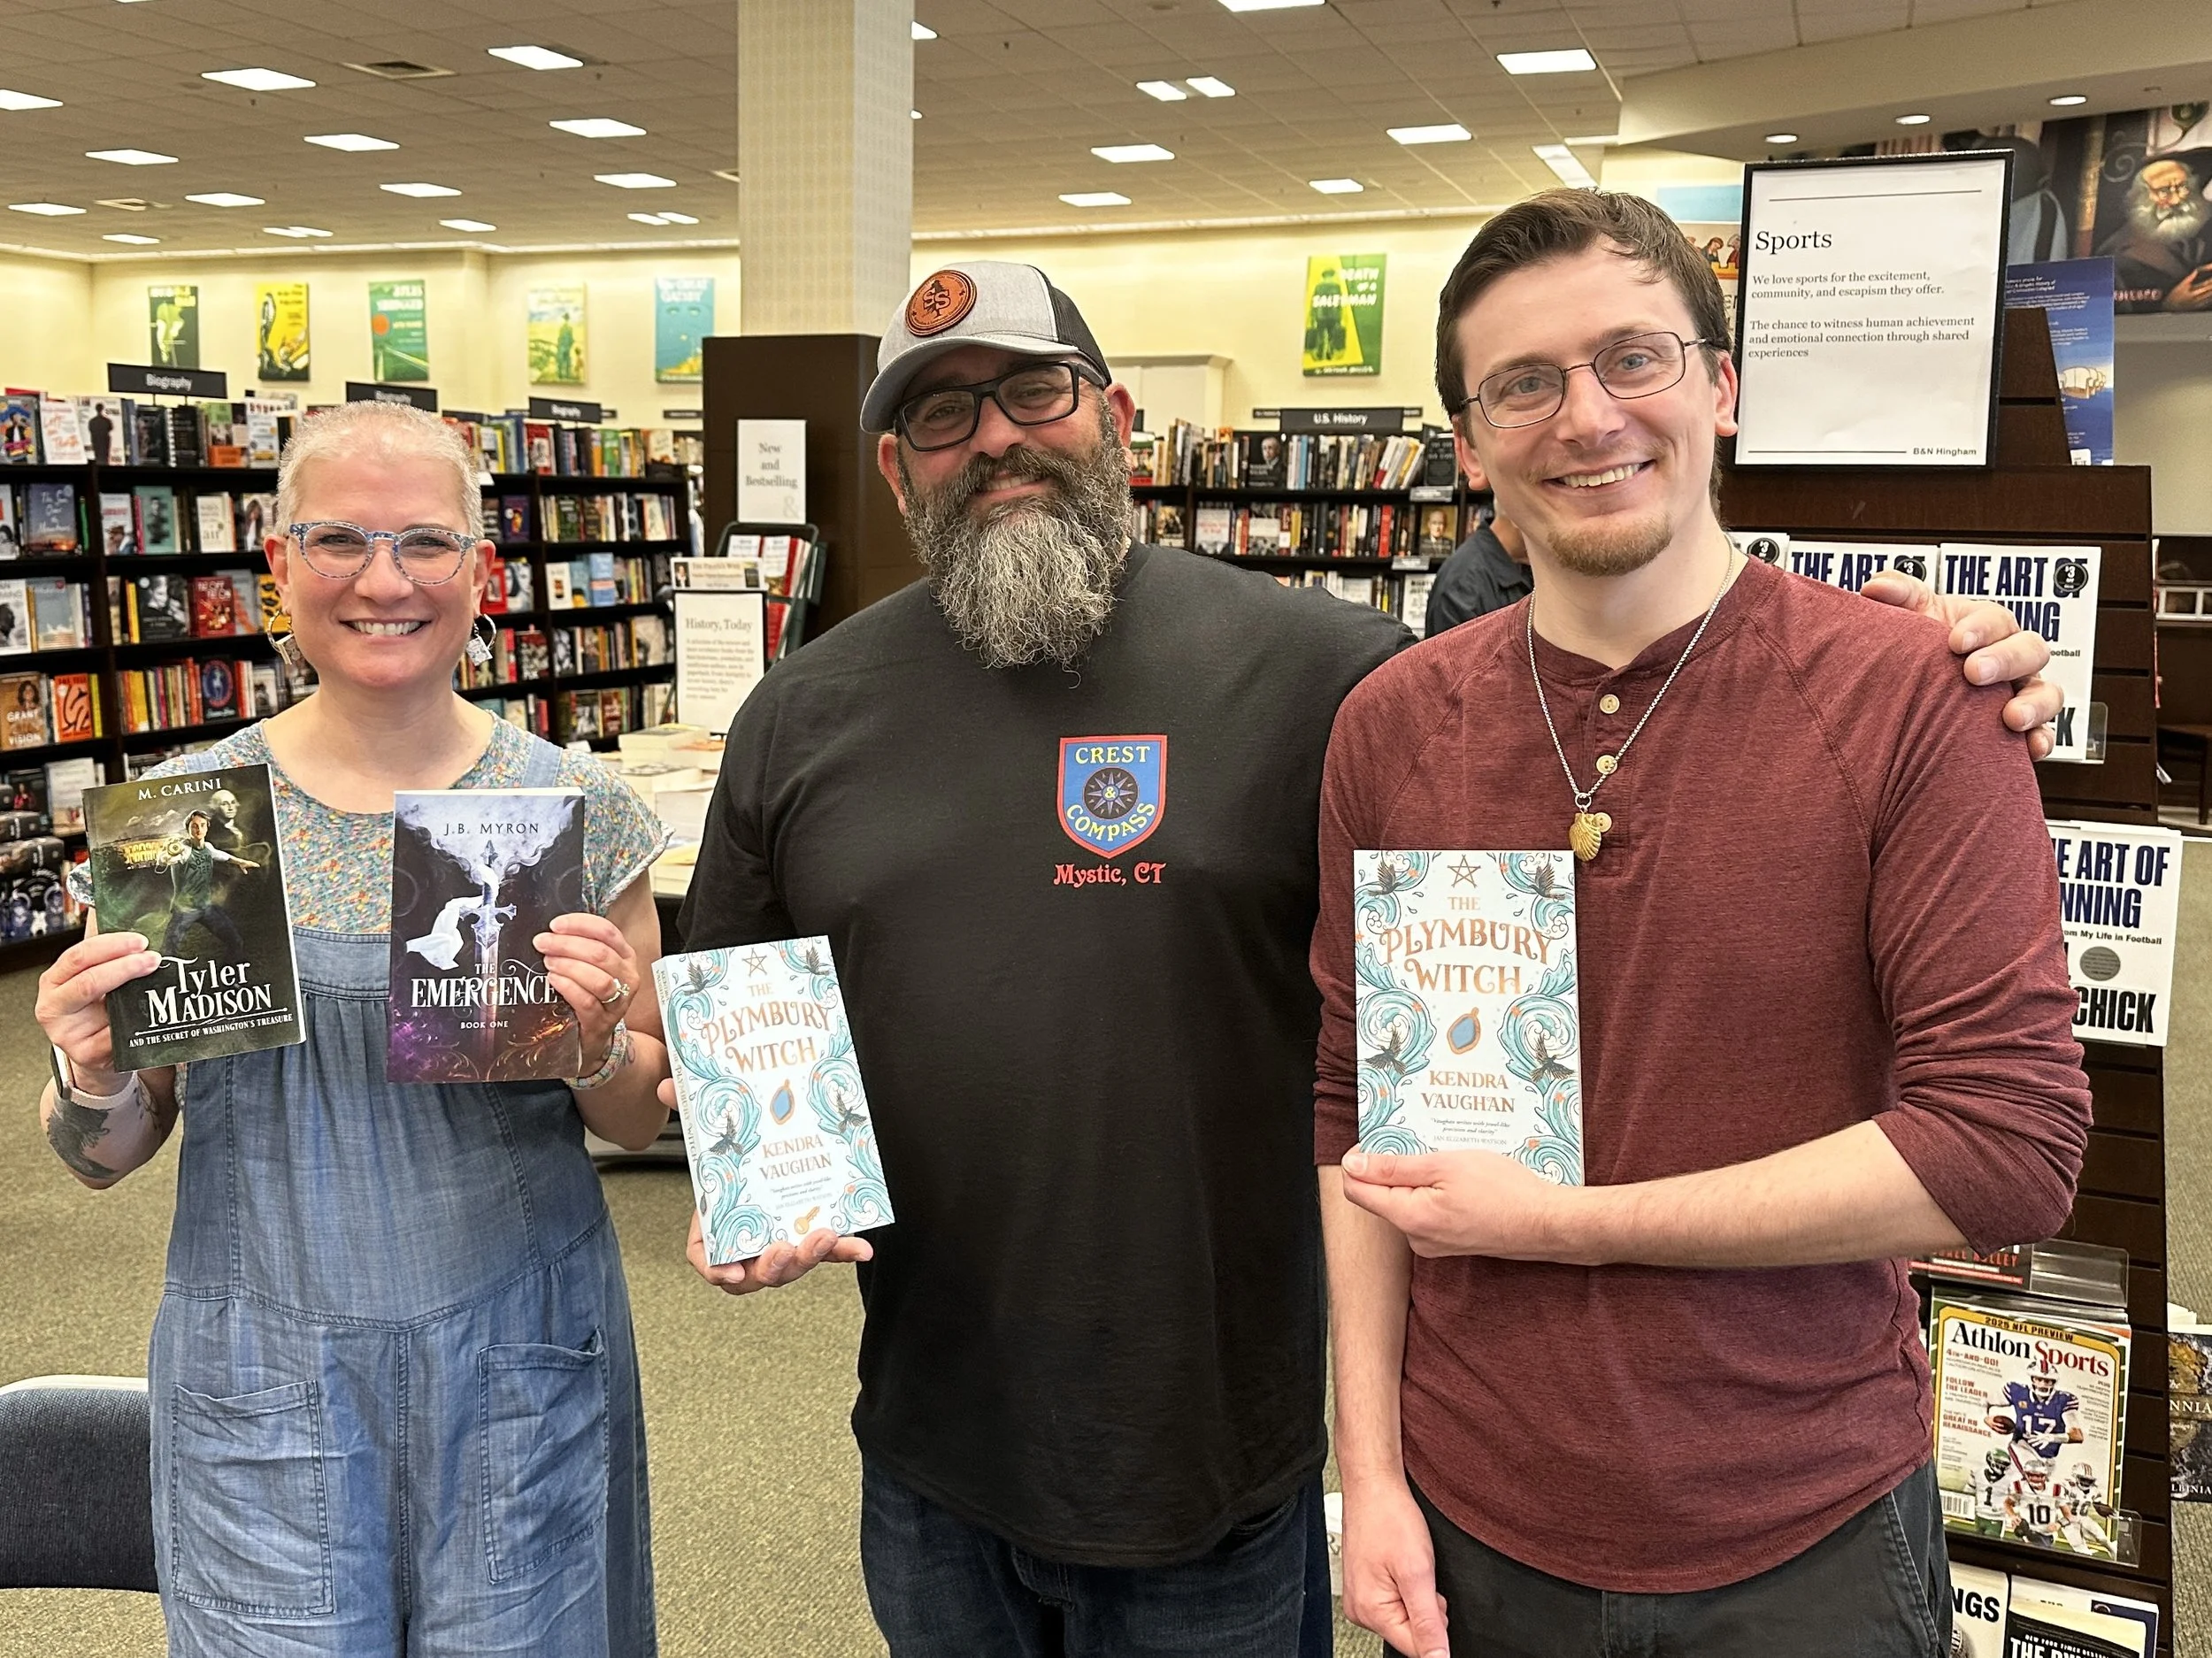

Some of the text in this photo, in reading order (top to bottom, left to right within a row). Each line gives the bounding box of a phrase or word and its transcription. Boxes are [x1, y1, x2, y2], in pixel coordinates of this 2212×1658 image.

[1755, 230, 1833, 255] Sports
[1753, 271, 1931, 287] We love sports for the excitement,
[1752, 283, 1945, 300] community, and escapism they offer.
[1749, 317, 1975, 330] The chance to witness human achievement
[1748, 330, 1970, 344] and emotional connection through shared
[1748, 348, 1809, 359] experiences
[146, 373, 193, 391] Biography
[1313, 413, 1368, 426] U.S. History
[758, 442, 780, 454] New
[1936, 447, 1977, 457] Hingham
[761, 458, 780, 471] and
[745, 475, 798, 489] Bestselling
[1792, 552, 1834, 584] THE
[1903, 562, 1915, 574] $3
[1945, 555, 1991, 595] THE
[1995, 557, 2048, 596] ART
[2065, 566, 2076, 579] $3
[686, 618, 752, 633] History, Today
[9, 733, 41, 747] VISION
[1075, 746, 1150, 764] CREST
[138, 778, 222, 801] M. CARINI
[1104, 787, 1116, 799] &
[444, 823, 539, 835] J.B. MYRON
[1066, 803, 1156, 841] COMPASS
[2075, 841, 2131, 883] ART
[2134, 845, 2170, 887] OF
[1054, 862, 1166, 888] Mystic, CT
[1448, 897, 1481, 910] THE
[2060, 883, 2142, 929] NNING
[1379, 918, 1555, 964] PLYMBURY
[2081, 930, 2093, 940] My
[2125, 934, 2162, 945] Football
[159, 956, 250, 999] Tyler
[475, 963, 495, 974] THE
[1404, 958, 1522, 994] WITCH
[411, 973, 558, 1009] EMERGENCE
[748, 982, 773, 997] THE
[145, 984, 272, 1028] MADISON
[2072, 986, 2157, 1033] CHICK
[129, 1014, 293, 1048] AND THE SECRET OF WASHINGTON'S TREASURE
[460, 1021, 485, 1030] BOOK
[701, 1001, 832, 1055] PLYMBURY
[726, 1037, 817, 1073] WITCH
[1430, 1071, 1509, 1089] KENDRA
[1421, 1093, 1515, 1113] VAUGHAN
[762, 1134, 823, 1158] KENDRA
[759, 1153, 832, 1180] VAUGHAN
[1973, 1249, 2017, 1267] LLEY
[1985, 1316, 2074, 1341] 2025 NFL PREVIEW
[1952, 1322, 2030, 1359] Athlon
[2034, 1340, 2109, 1377] Sports
[1946, 1376, 1975, 1387] FOLLOW
[1961, 1387, 1987, 1398] LEADER
[2170, 1400, 2212, 1415] NNIA
[2022, 1416, 2056, 1438] 17
[1984, 1486, 1993, 1506] 1
[2028, 1504, 2051, 1524] 10
[1951, 1586, 2001, 1623] NGS
[2024, 1634, 2039, 1643] NEW
